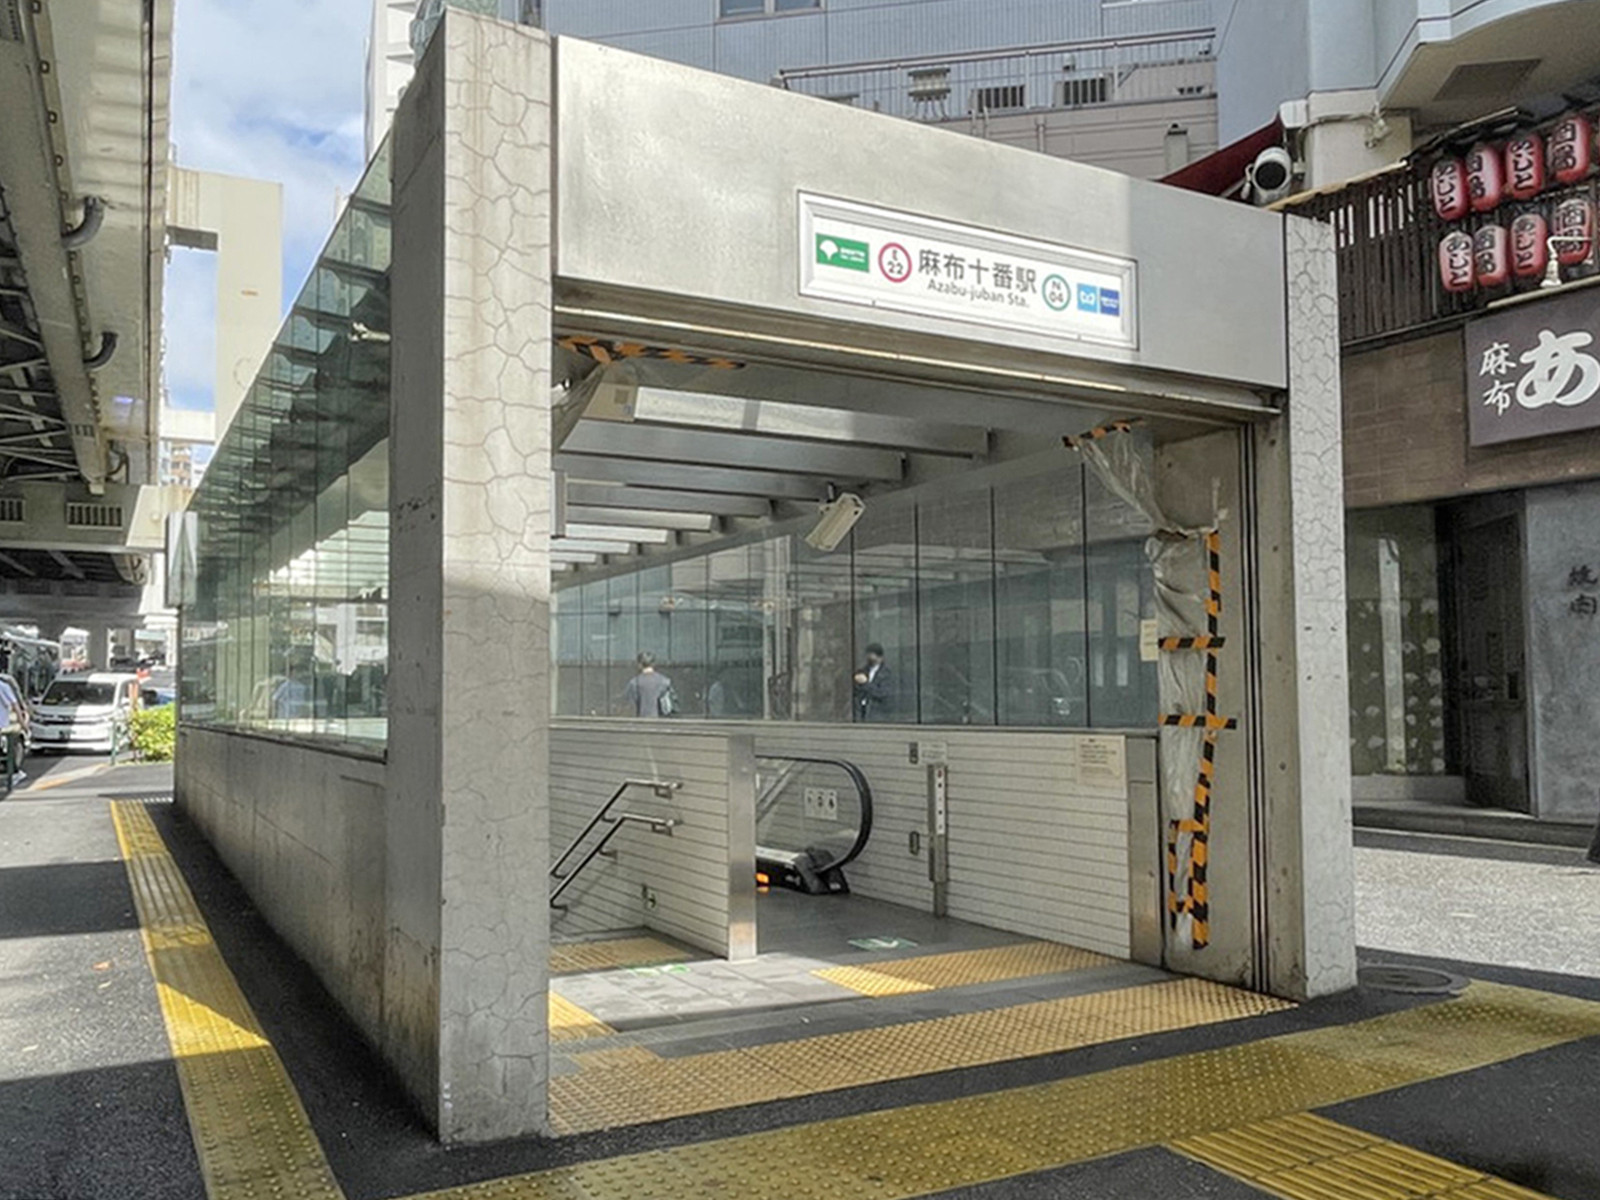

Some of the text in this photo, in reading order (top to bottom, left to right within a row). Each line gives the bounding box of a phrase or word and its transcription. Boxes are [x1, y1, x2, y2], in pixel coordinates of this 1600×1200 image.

[918, 249, 1038, 295] 麻布十番駅
[927, 278, 1030, 308] Azabu-juban Sta.
[1479, 341, 1517, 417] 麻布
[1516, 329, 1600, 409] あ
